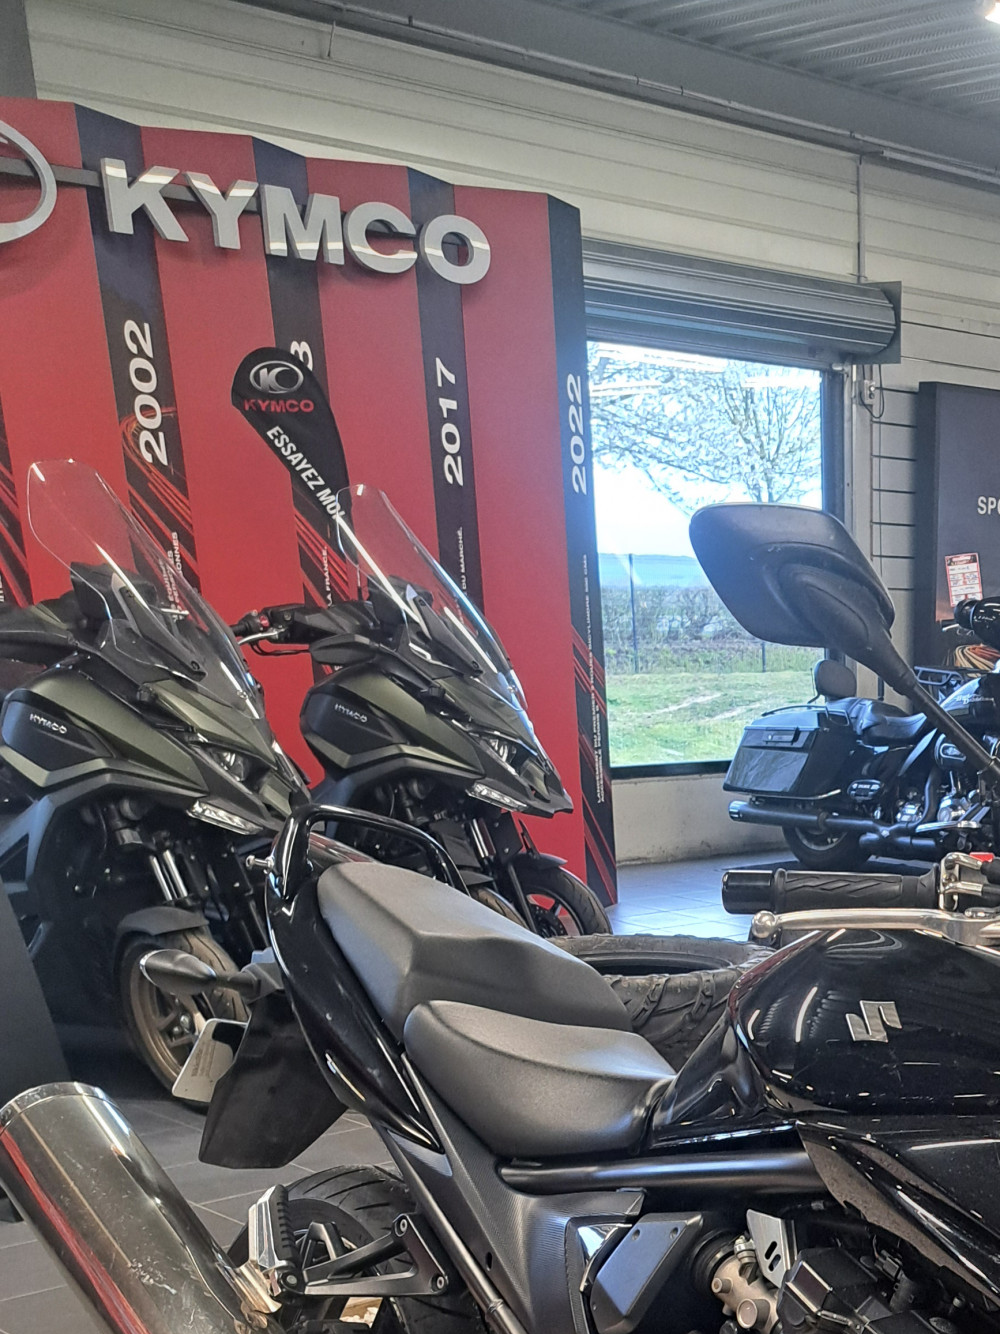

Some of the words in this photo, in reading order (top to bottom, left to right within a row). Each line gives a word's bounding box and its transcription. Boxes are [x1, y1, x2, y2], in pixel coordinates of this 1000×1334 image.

[100, 157, 491, 285] KYMCO
[123, 320, 169, 467] 2002
[243, 398, 315, 414] KYMCO
[434, 357, 464, 487] 2017
[566, 373, 588, 495] 2022
[266, 426, 323, 491] ESSAYEZ
[317, 487, 346, 521] MOI
[29, 713, 68, 734] KYMCO
